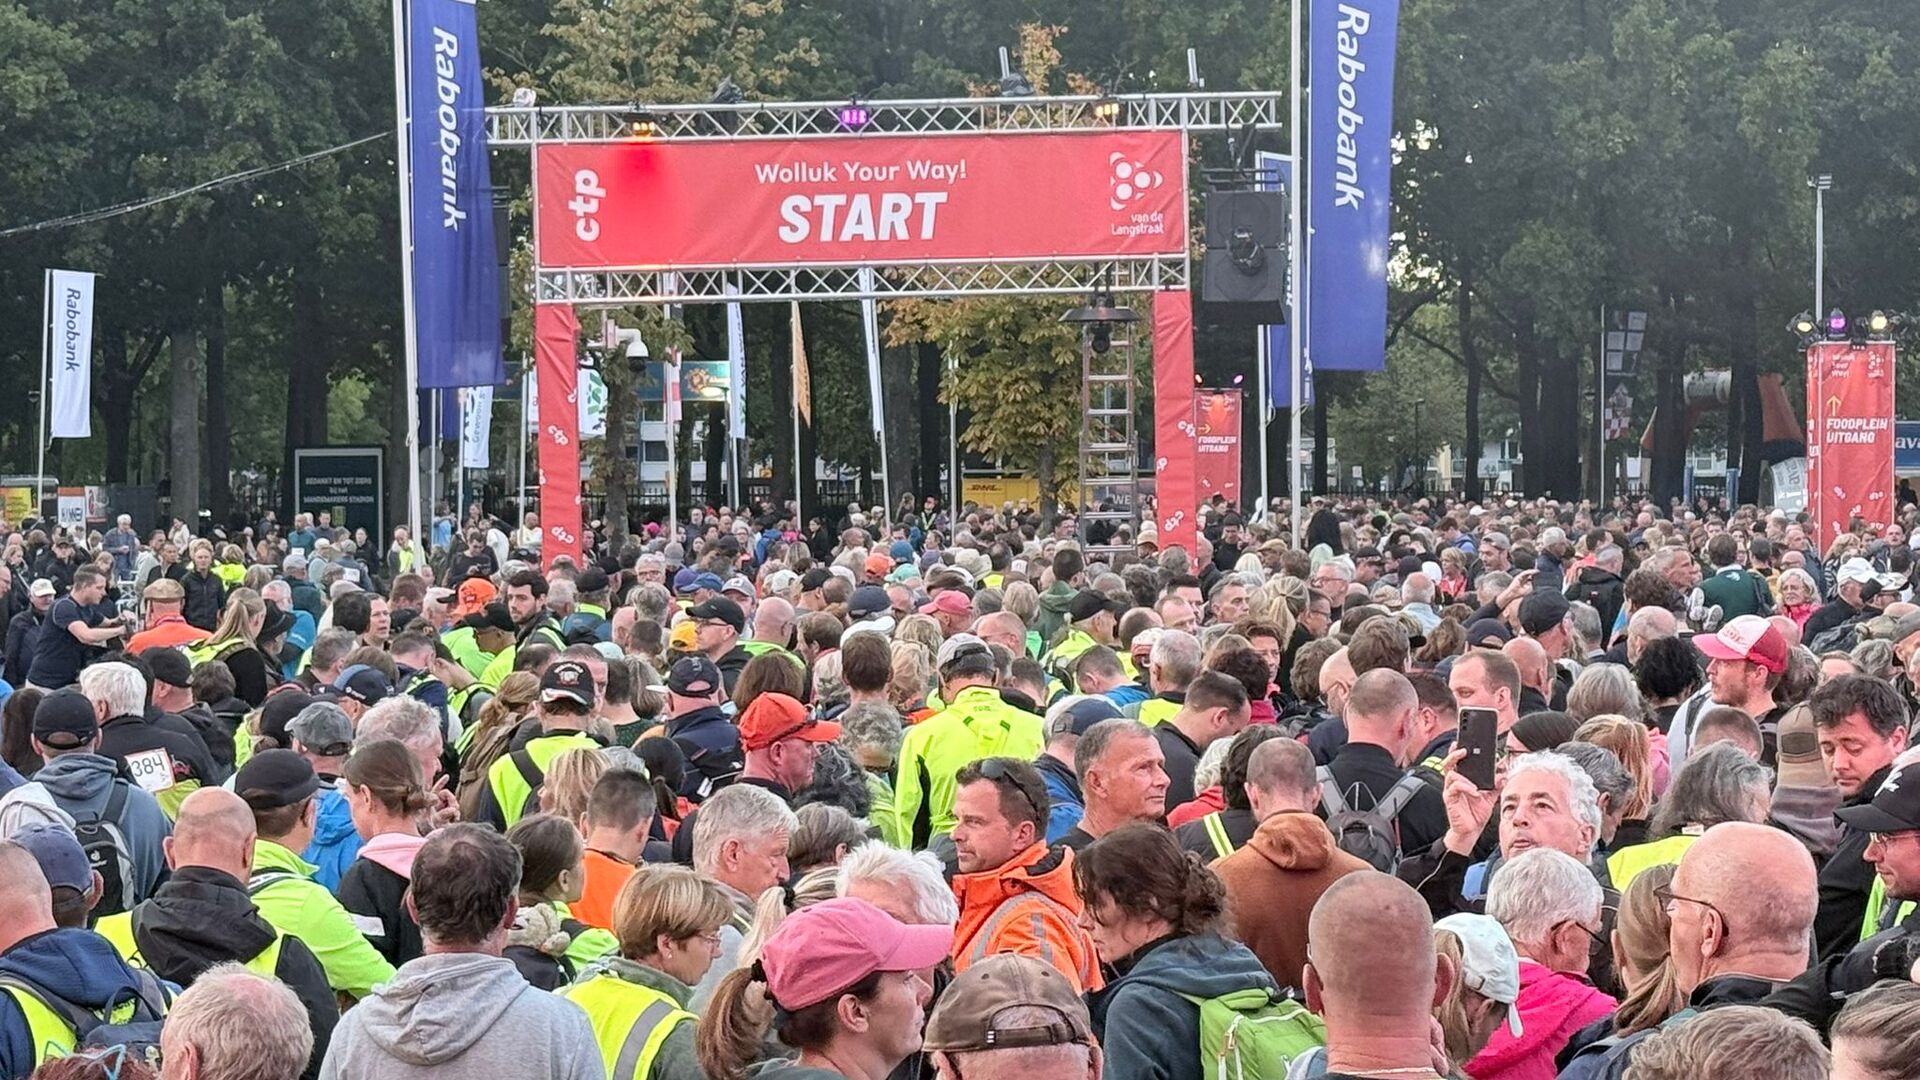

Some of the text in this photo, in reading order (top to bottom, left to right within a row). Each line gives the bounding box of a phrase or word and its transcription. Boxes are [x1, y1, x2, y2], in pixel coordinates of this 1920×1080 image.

[1335, 3, 1371, 211] Rabobank
[433, 26, 467, 232] Rabobank
[755, 158, 967, 184] Wolluk Your Way!
[568, 169, 607, 242] ctp
[1131, 210, 1164, 223] van de
[778, 192, 948, 244] START
[1111, 222, 1164, 238] Langstraat
[65, 287, 81, 372] Rabobank
[1826, 418, 1888, 430] FOODPLEIN
[547, 425, 569, 446] ctp
[1826, 431, 1875, 443] UITGANG
[1164, 510, 1184, 532] ctp
[551, 525, 575, 545] ctp
[131, 754, 166, 777] 384
